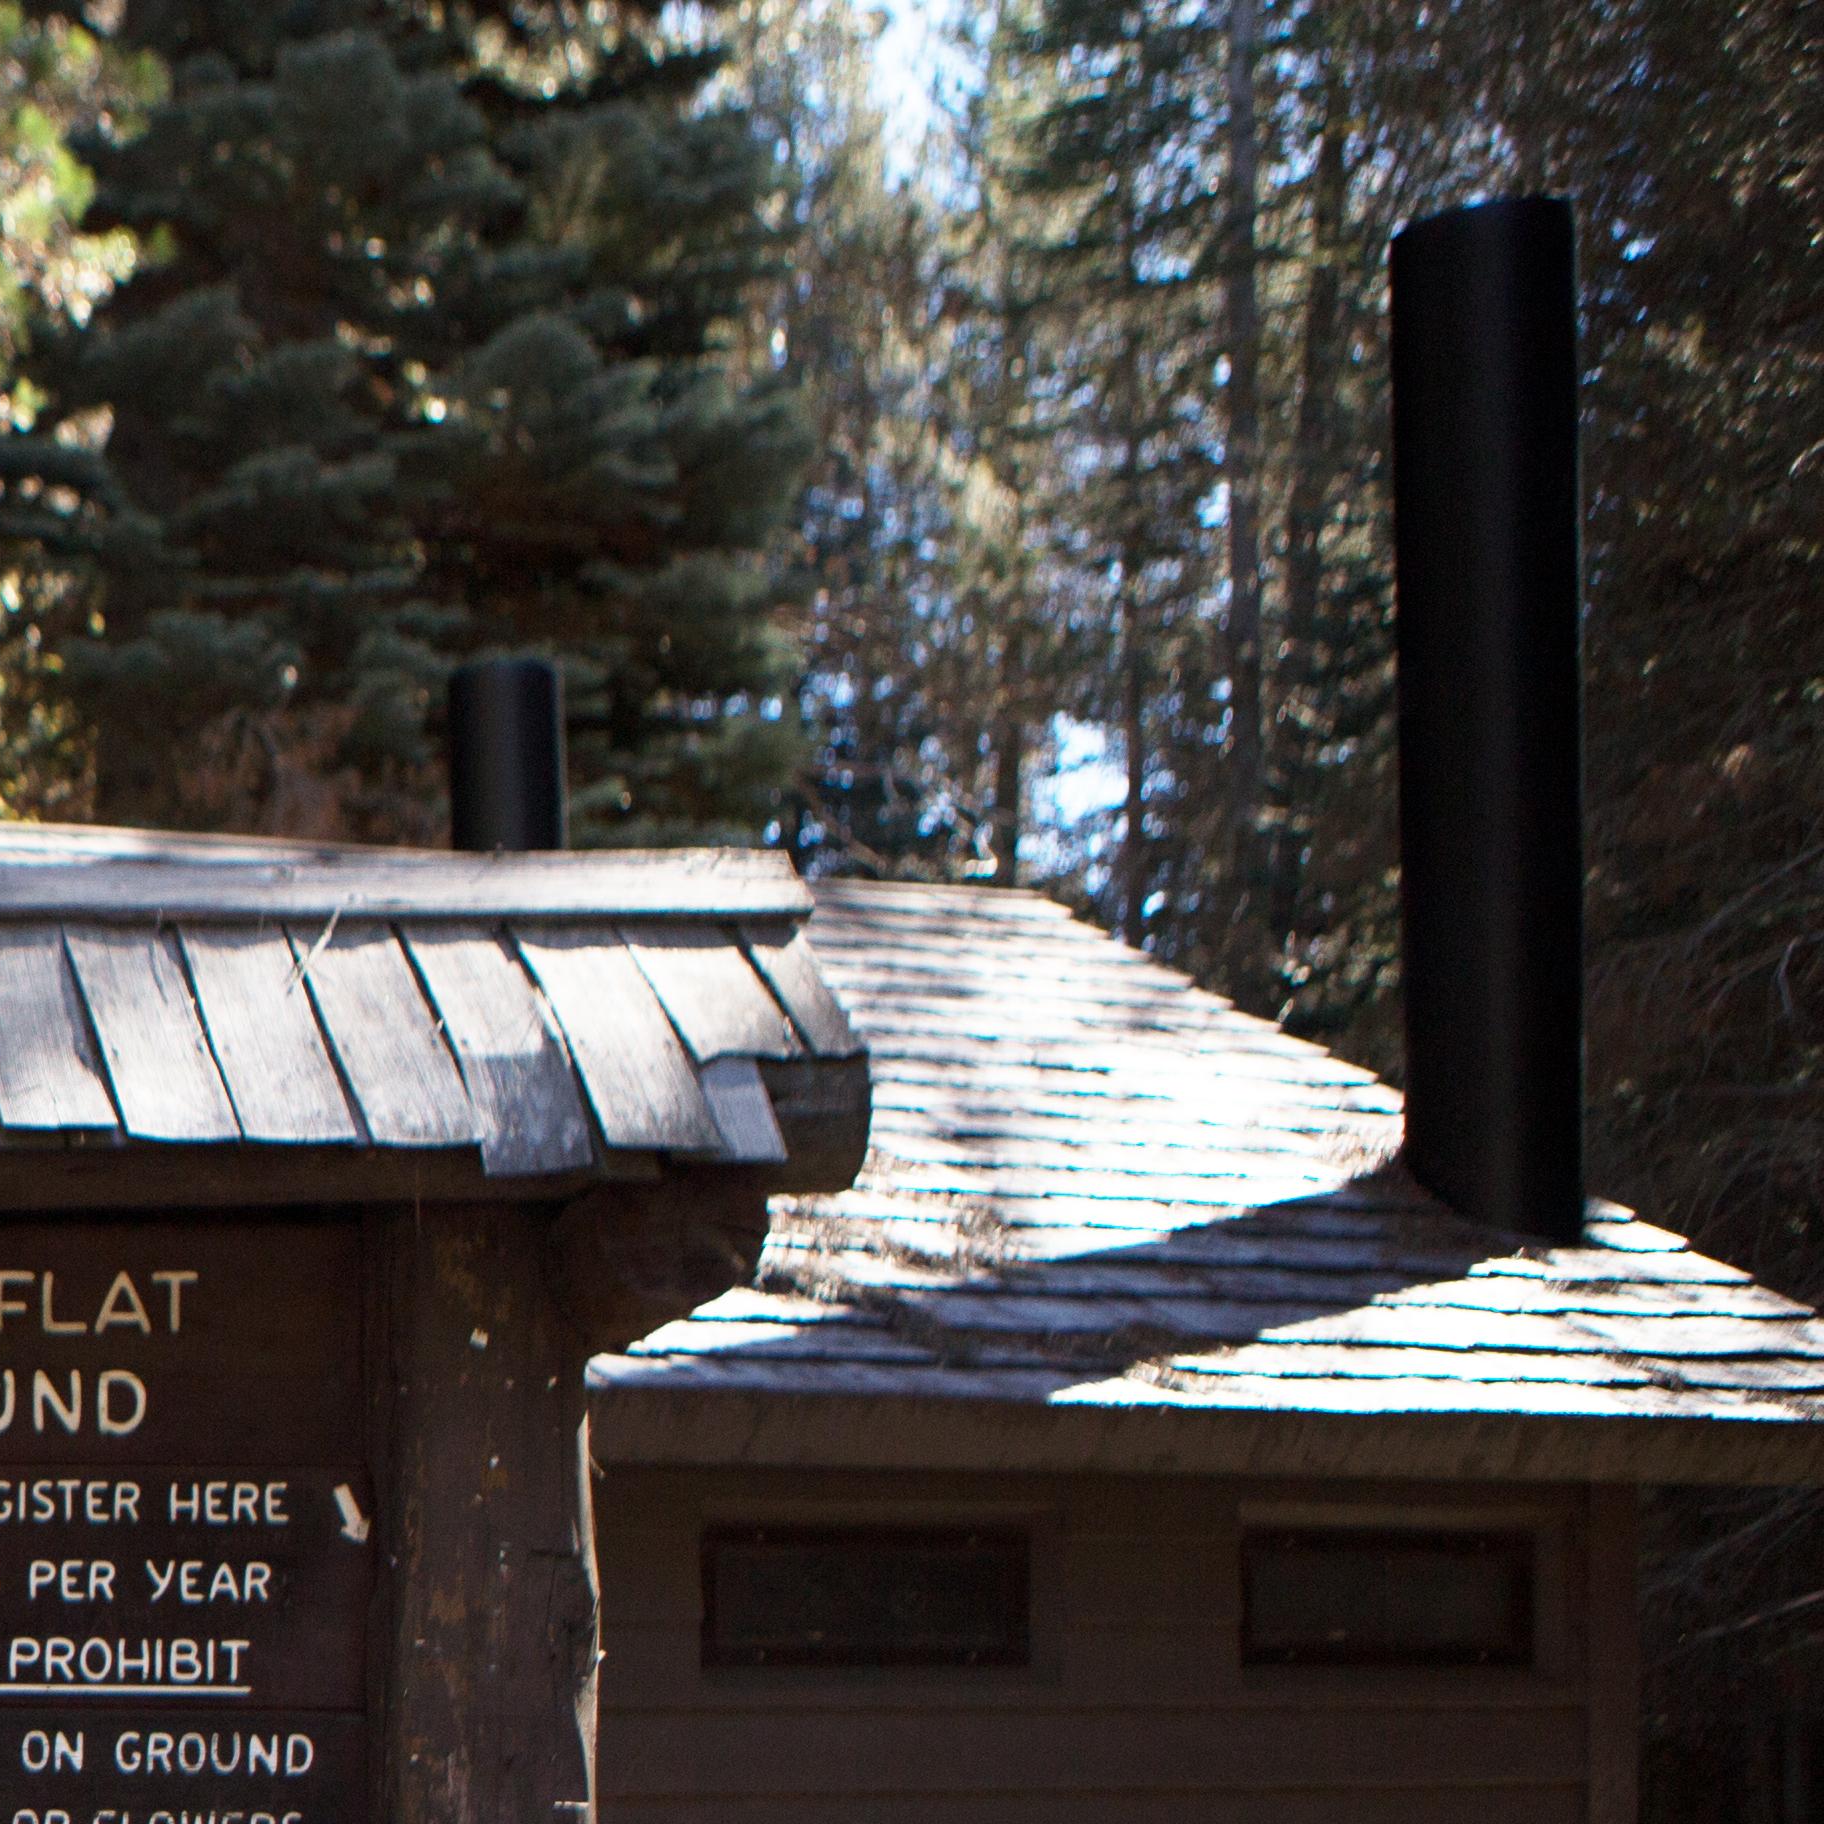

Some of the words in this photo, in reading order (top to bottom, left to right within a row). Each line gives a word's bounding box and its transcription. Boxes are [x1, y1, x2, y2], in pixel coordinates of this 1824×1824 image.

[170, 1482, 288, 1522] HERE
[29, 1560, 115, 1600] PER
[147, 1560, 271, 1602] YEAR
[10, 1638, 249, 1681] PROHIBIT
[22, 1731, 83, 1771] ON
[116, 1732, 314, 1774] GROUND
